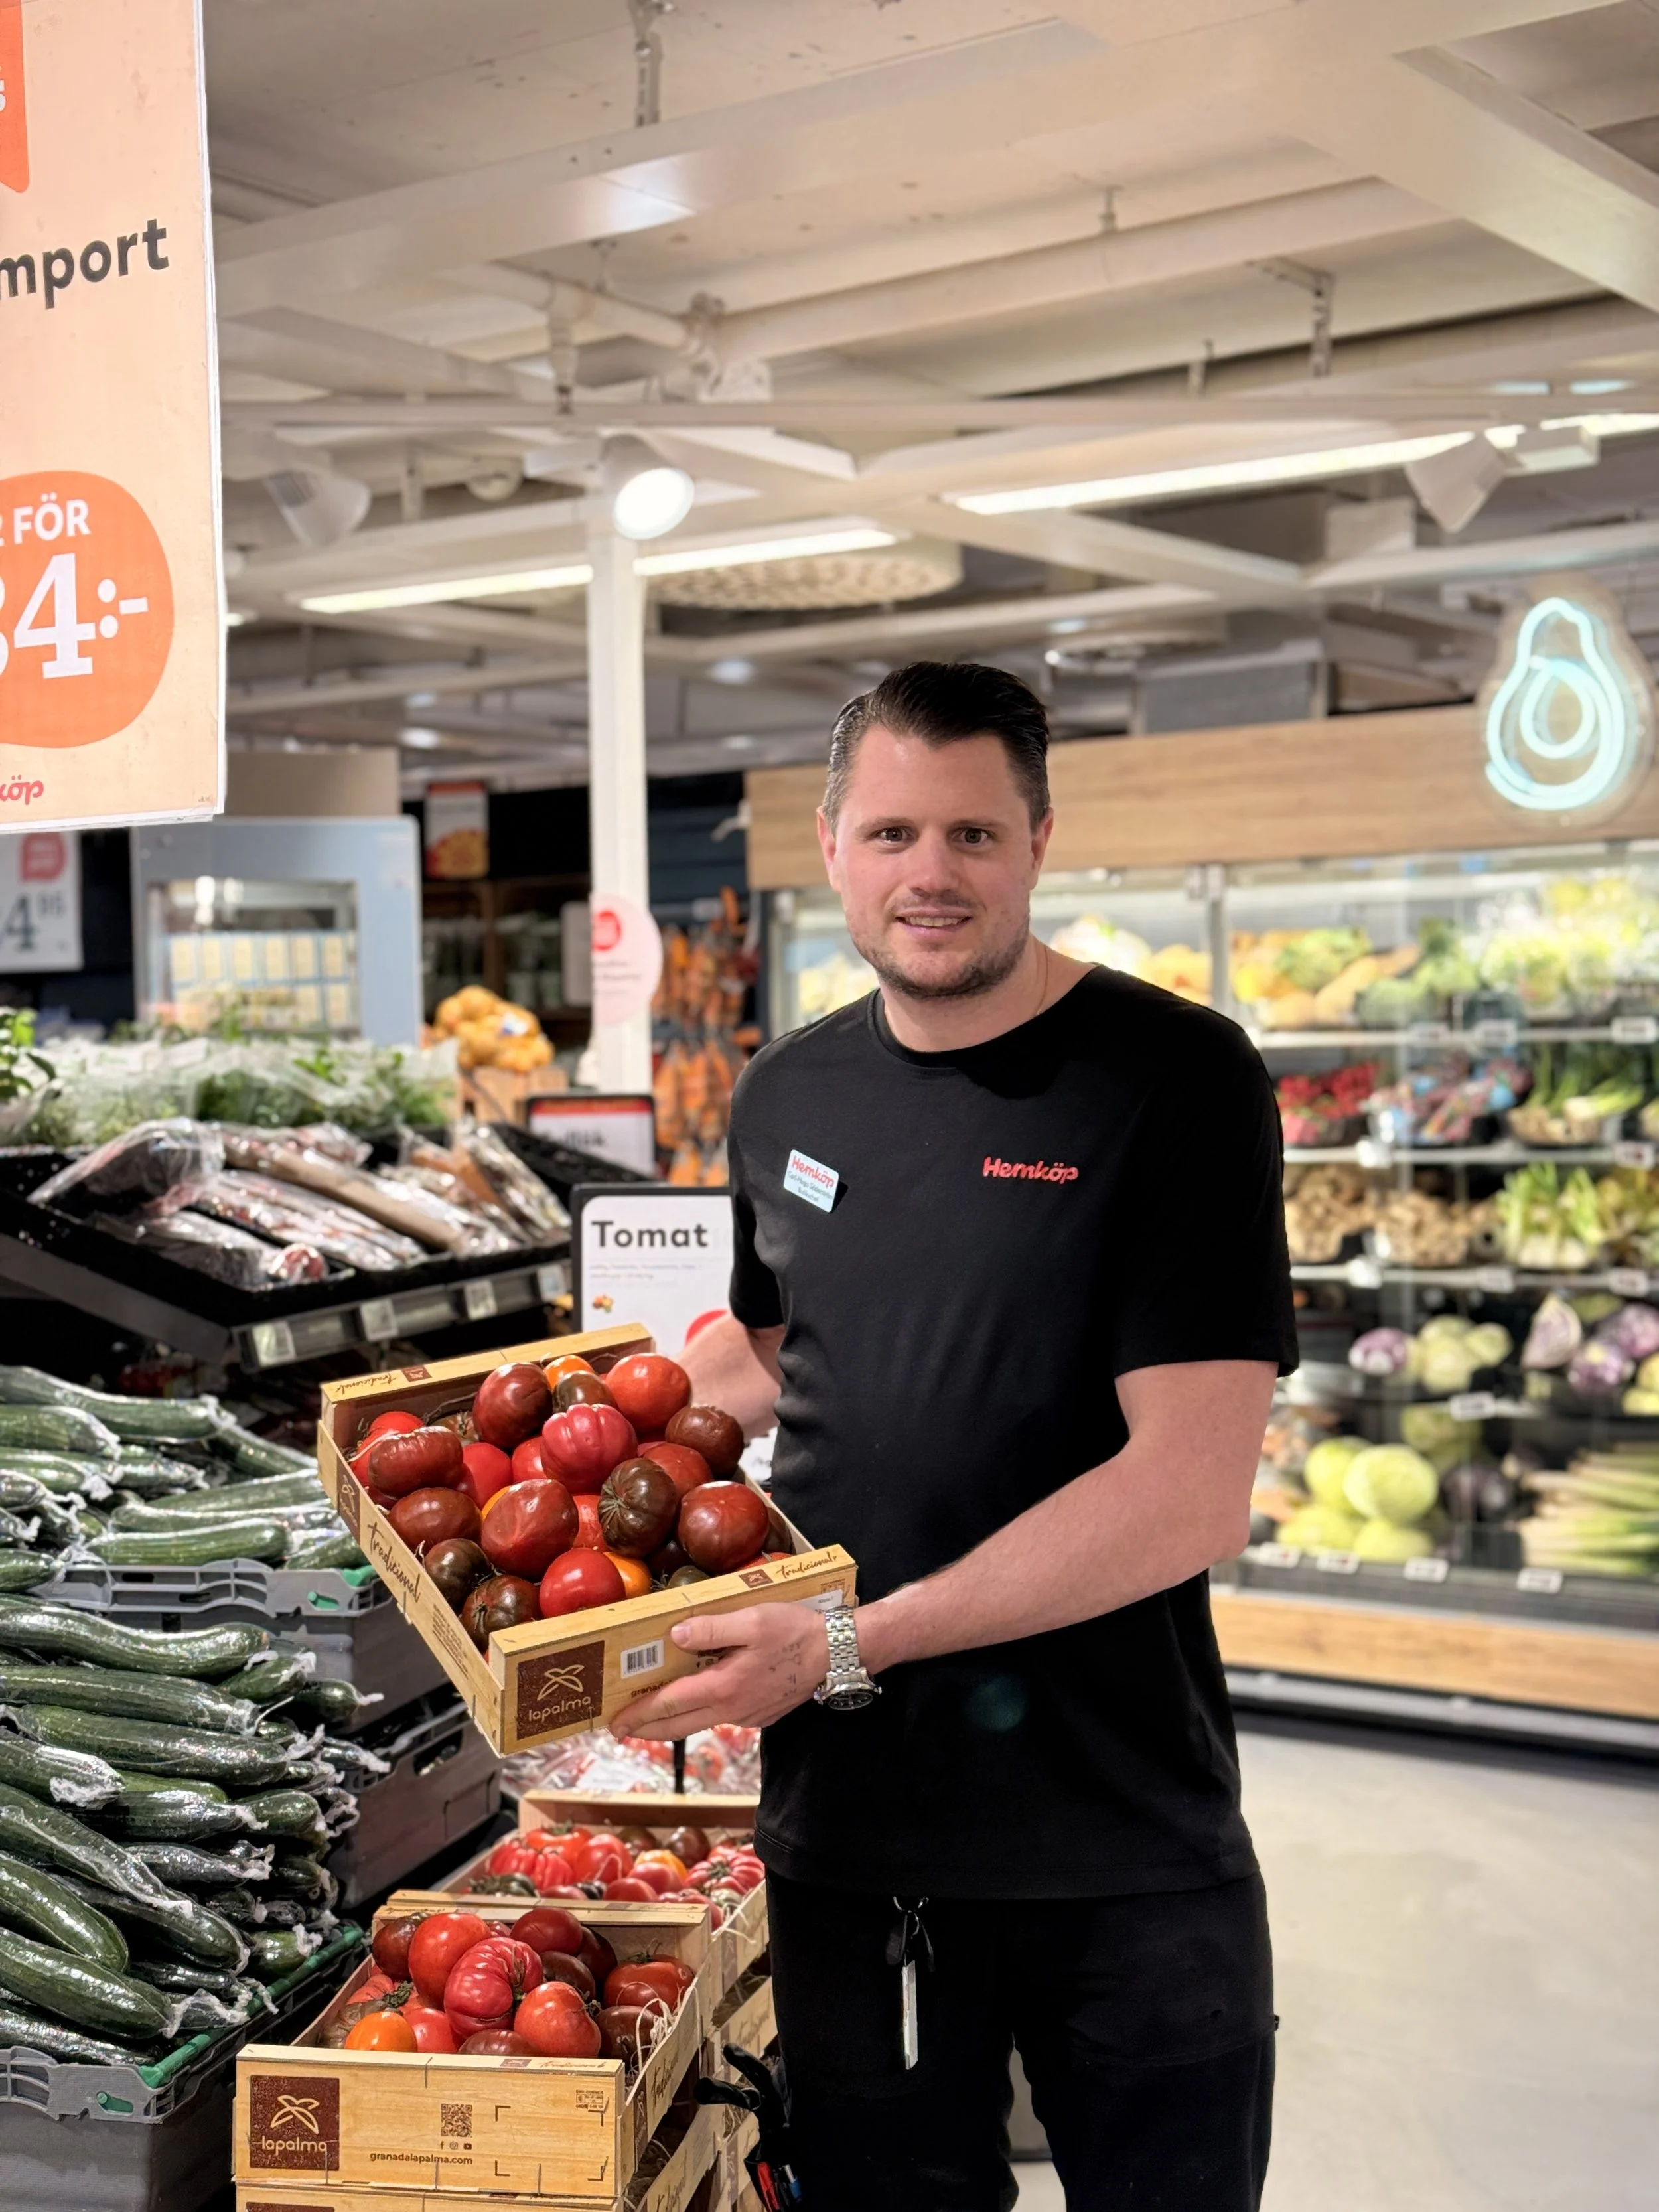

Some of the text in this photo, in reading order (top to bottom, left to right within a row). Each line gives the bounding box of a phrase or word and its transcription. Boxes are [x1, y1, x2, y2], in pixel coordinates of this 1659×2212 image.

[0, 218, 169, 310] mport
[13, 492, 92, 544] FÖR
[0, 552, 149, 680] 4:-
[792, 1155, 835, 1189] Hemköp
[982, 1156, 1079, 1185] Hemköp
[591, 1221, 708, 1248] Tomat
[528, 1696, 591, 1723] lapalma
[261, 2135, 327, 2156] lapalma
[370, 2152, 473, 2165] granadalapalma.com
